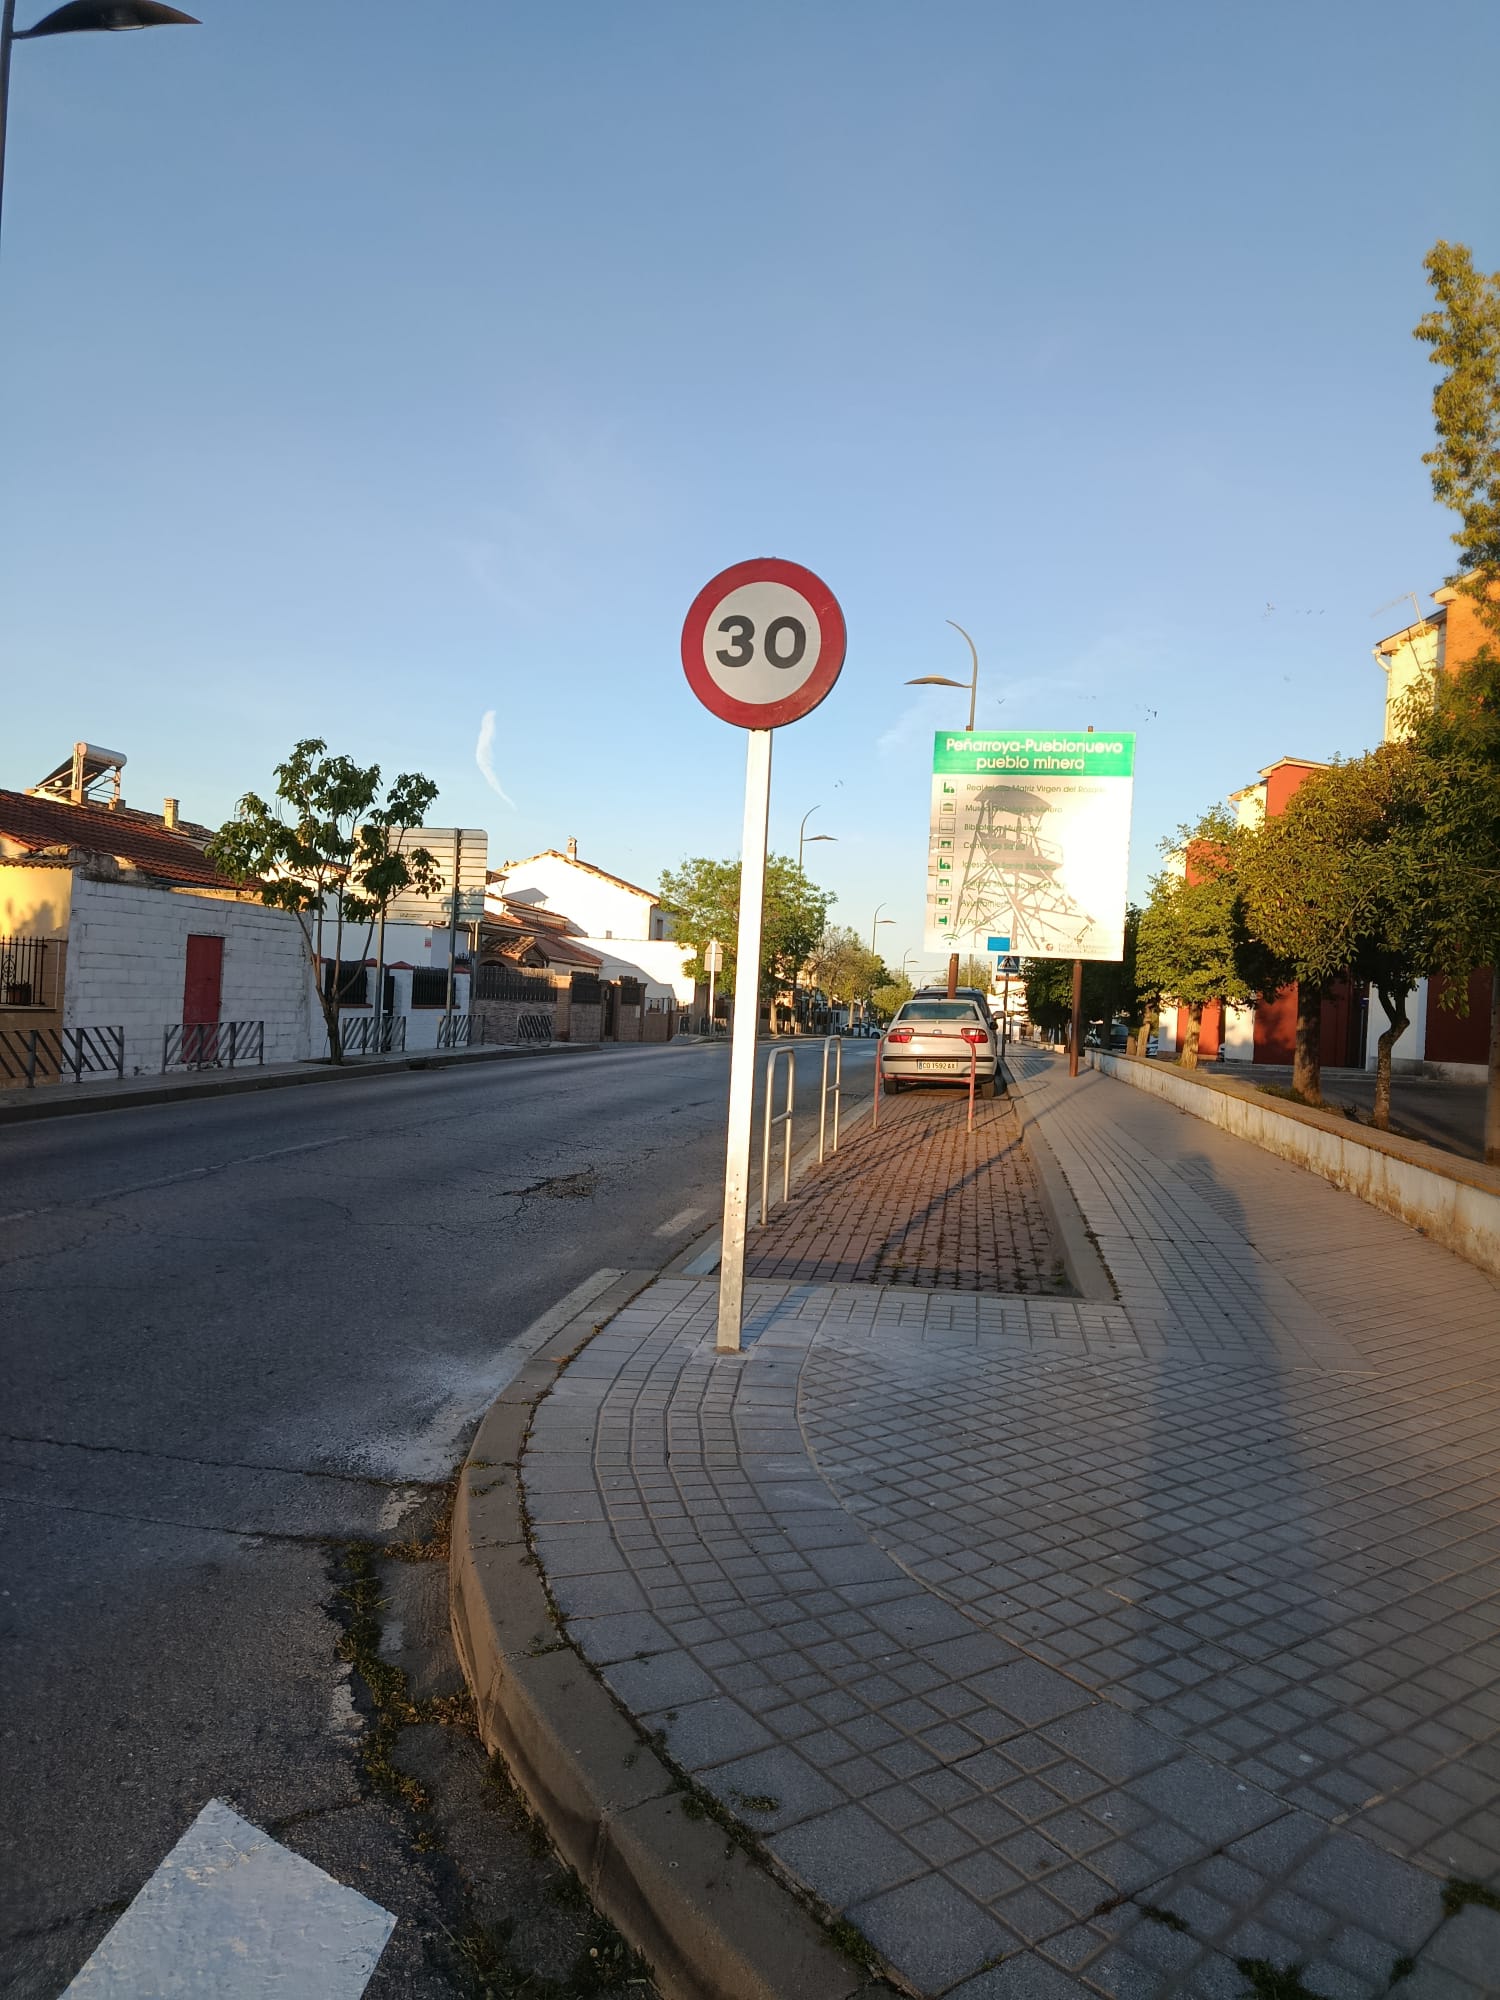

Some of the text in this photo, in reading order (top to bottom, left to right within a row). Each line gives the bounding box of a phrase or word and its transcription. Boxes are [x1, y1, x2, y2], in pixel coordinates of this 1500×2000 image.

[716, 614, 807, 670] 30
[946, 737, 1123, 755] Peñarroya-Pueblonuevo
[976, 755, 1086, 771] pueblo minero
[1037, 785, 1062, 793] Virgen
